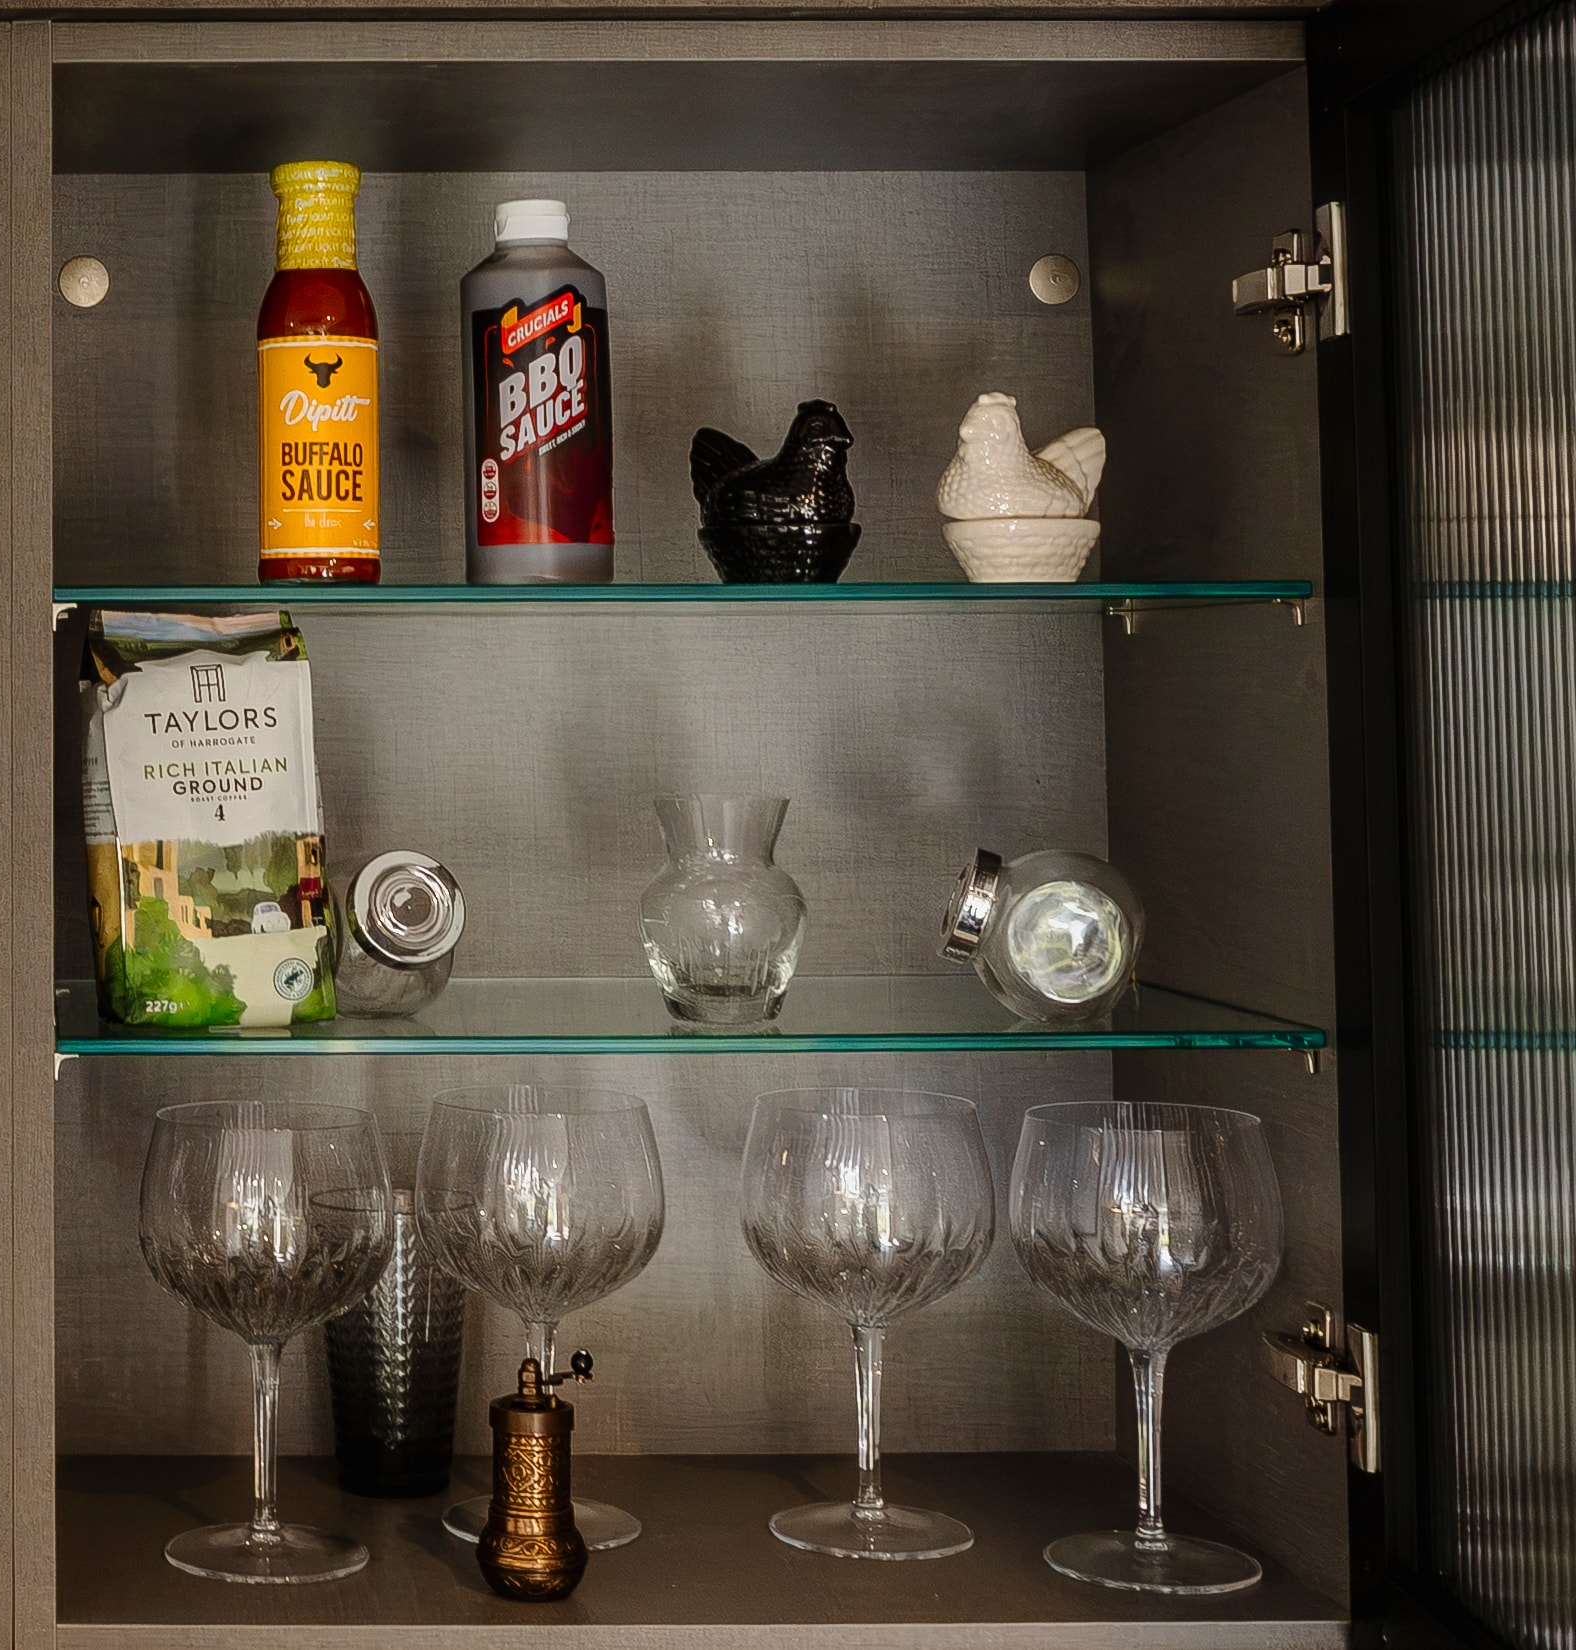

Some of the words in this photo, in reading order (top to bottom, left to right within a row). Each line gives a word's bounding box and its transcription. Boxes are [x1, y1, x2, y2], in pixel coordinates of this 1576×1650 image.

[507, 299, 569, 348] CRUCIALS
[499, 335, 583, 429] BBQ
[280, 390, 371, 432] Dipitt
[500, 378, 585, 461] SAUCE
[281, 442, 363, 467] BUFFALO
[281, 469, 363, 502] SAUCE
[144, 706, 277, 735] TAYLORS
[171, 739, 185, 749] OF
[190, 735, 256, 748] HARROGATE
[143, 761, 196, 780] RICH
[204, 756, 288, 777] ITALIAN
[172, 776, 263, 795] GROUND
[214, 803, 226, 822] 4
[145, 1000, 178, 1015] 227g
